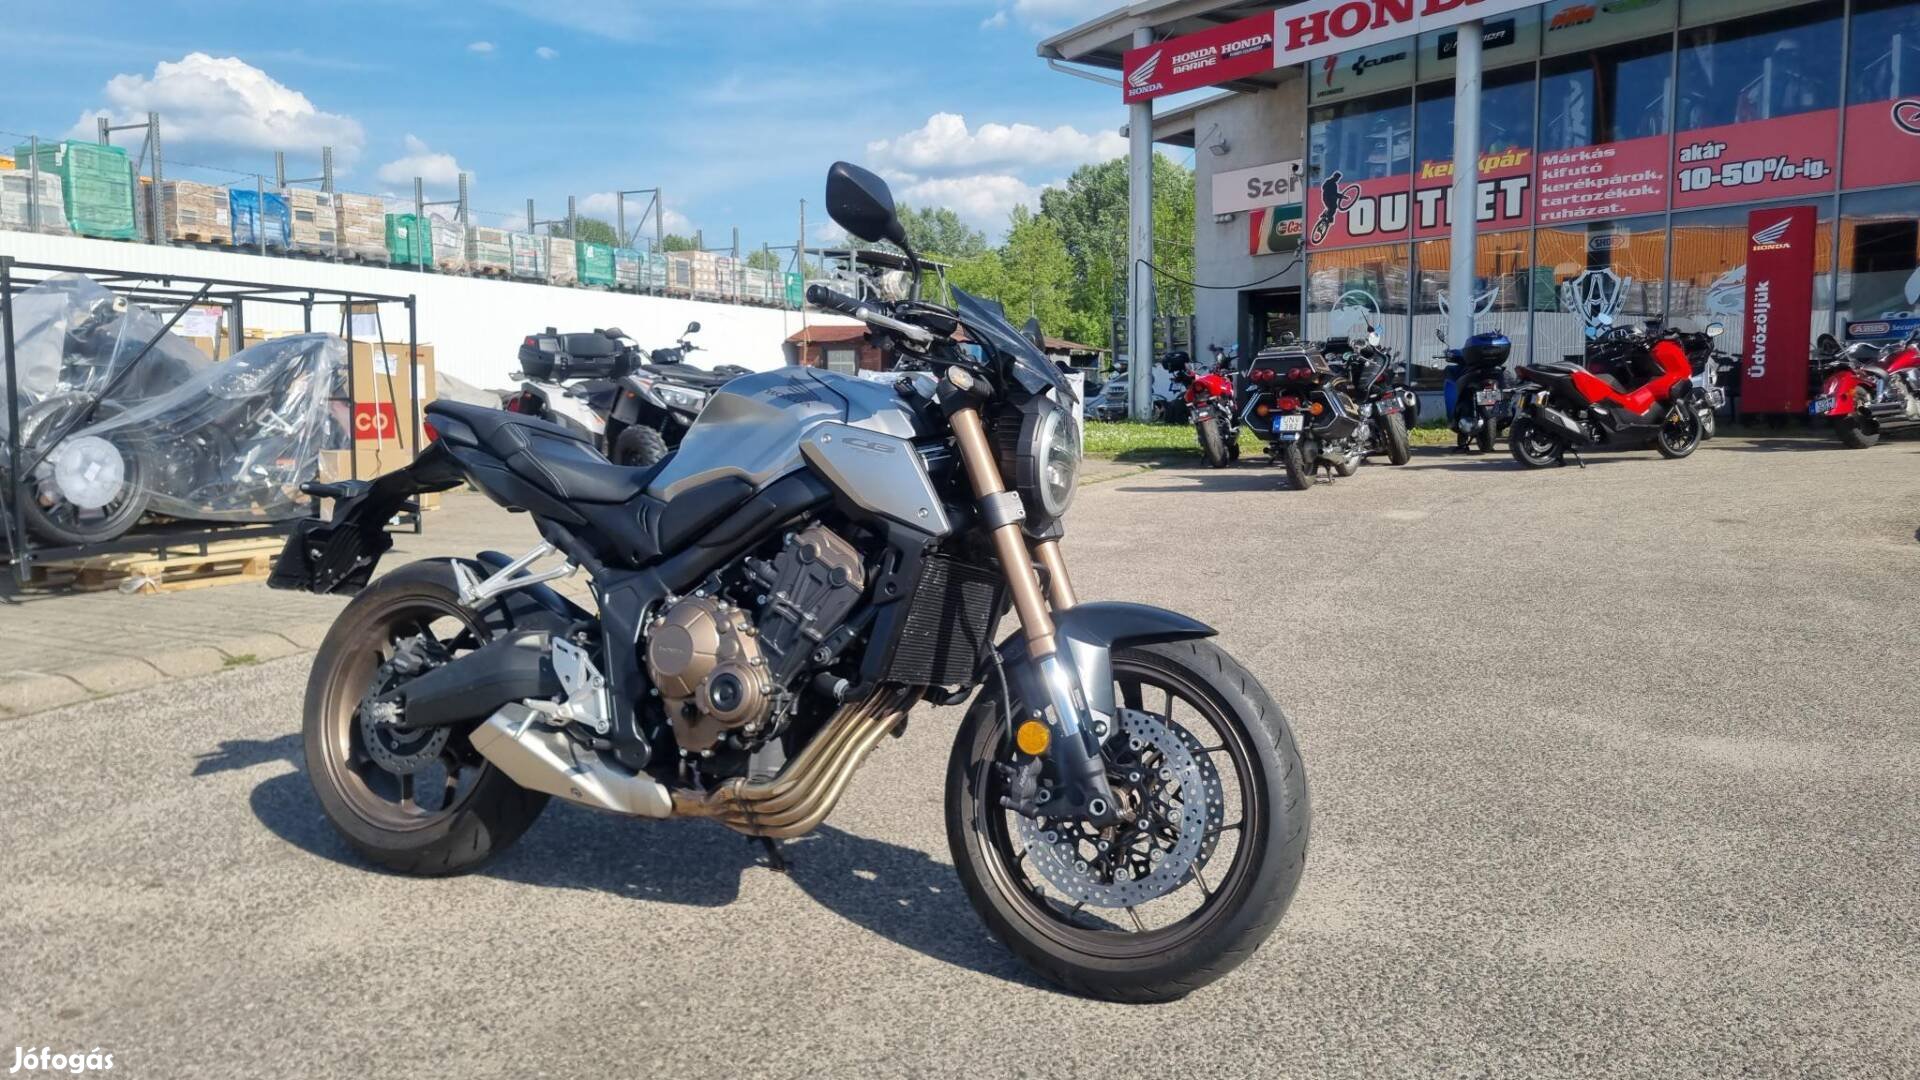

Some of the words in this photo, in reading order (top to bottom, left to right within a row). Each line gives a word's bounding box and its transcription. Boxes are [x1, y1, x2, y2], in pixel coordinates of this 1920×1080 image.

[1285, 0, 1485, 51] HON
[1221, 33, 1272, 54] HONDA
[1171, 46, 1217, 65] HONDA
[1173, 57, 1217, 75] MARINE
[1128, 82, 1164, 97] HONDA
[1542, 147, 1616, 166] Márkás
[1680, 142, 1727, 163] akár
[1542, 162, 1603, 180] kifutó
[1678, 156, 1831, 192] 10-50%-ig.
[1540, 203, 1627, 221] ruházat.
[1753, 243, 1791, 252] HONDA
[1748, 280, 1771, 378] Üdvözöljük
